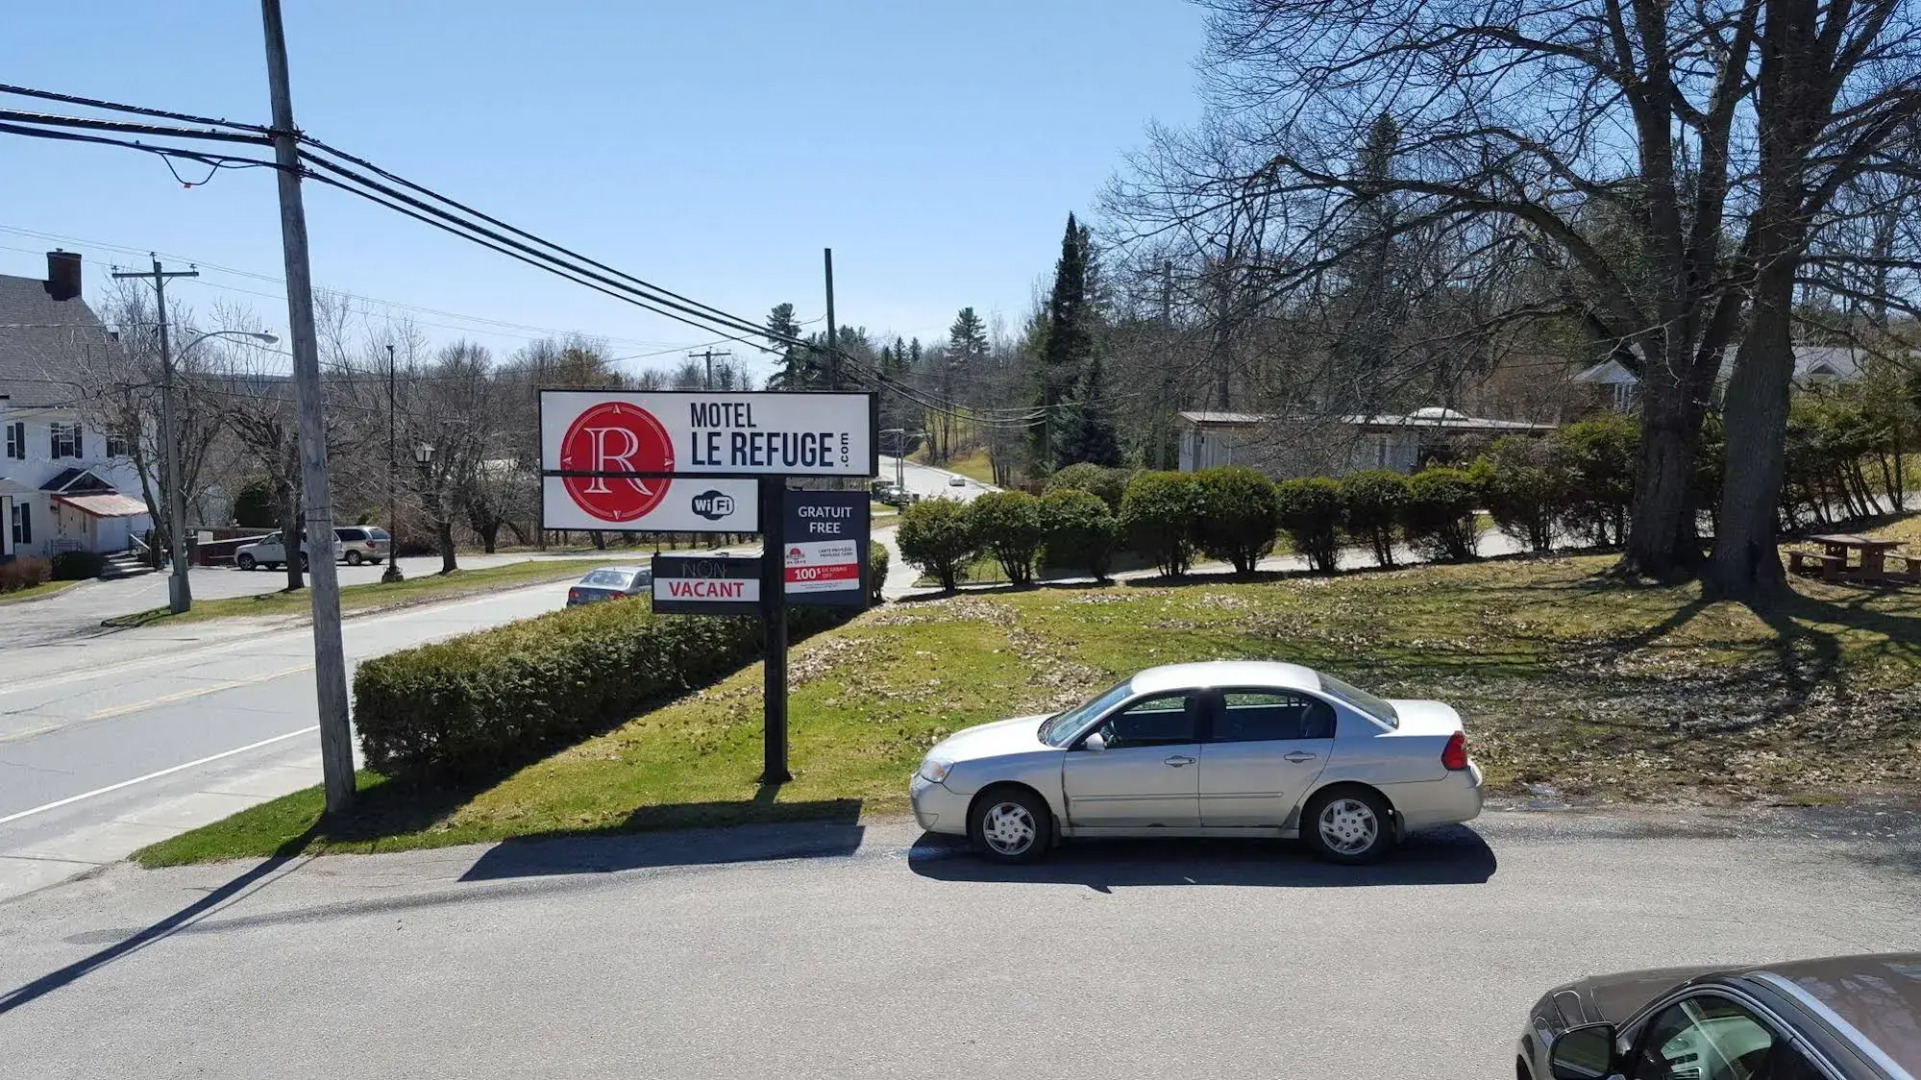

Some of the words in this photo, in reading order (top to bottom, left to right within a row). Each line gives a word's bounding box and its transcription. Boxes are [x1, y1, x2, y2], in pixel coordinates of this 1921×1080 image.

[690, 402, 757, 428] MOTEL
[691, 431, 722, 466] LE
[731, 432, 834, 467] REFUGE
[583, 427, 654, 496] R
[798, 506, 853, 518] GRATUIT
[809, 522, 841, 533] FREE
[682, 560, 728, 578] NON
[669, 582, 744, 598] VACANT
